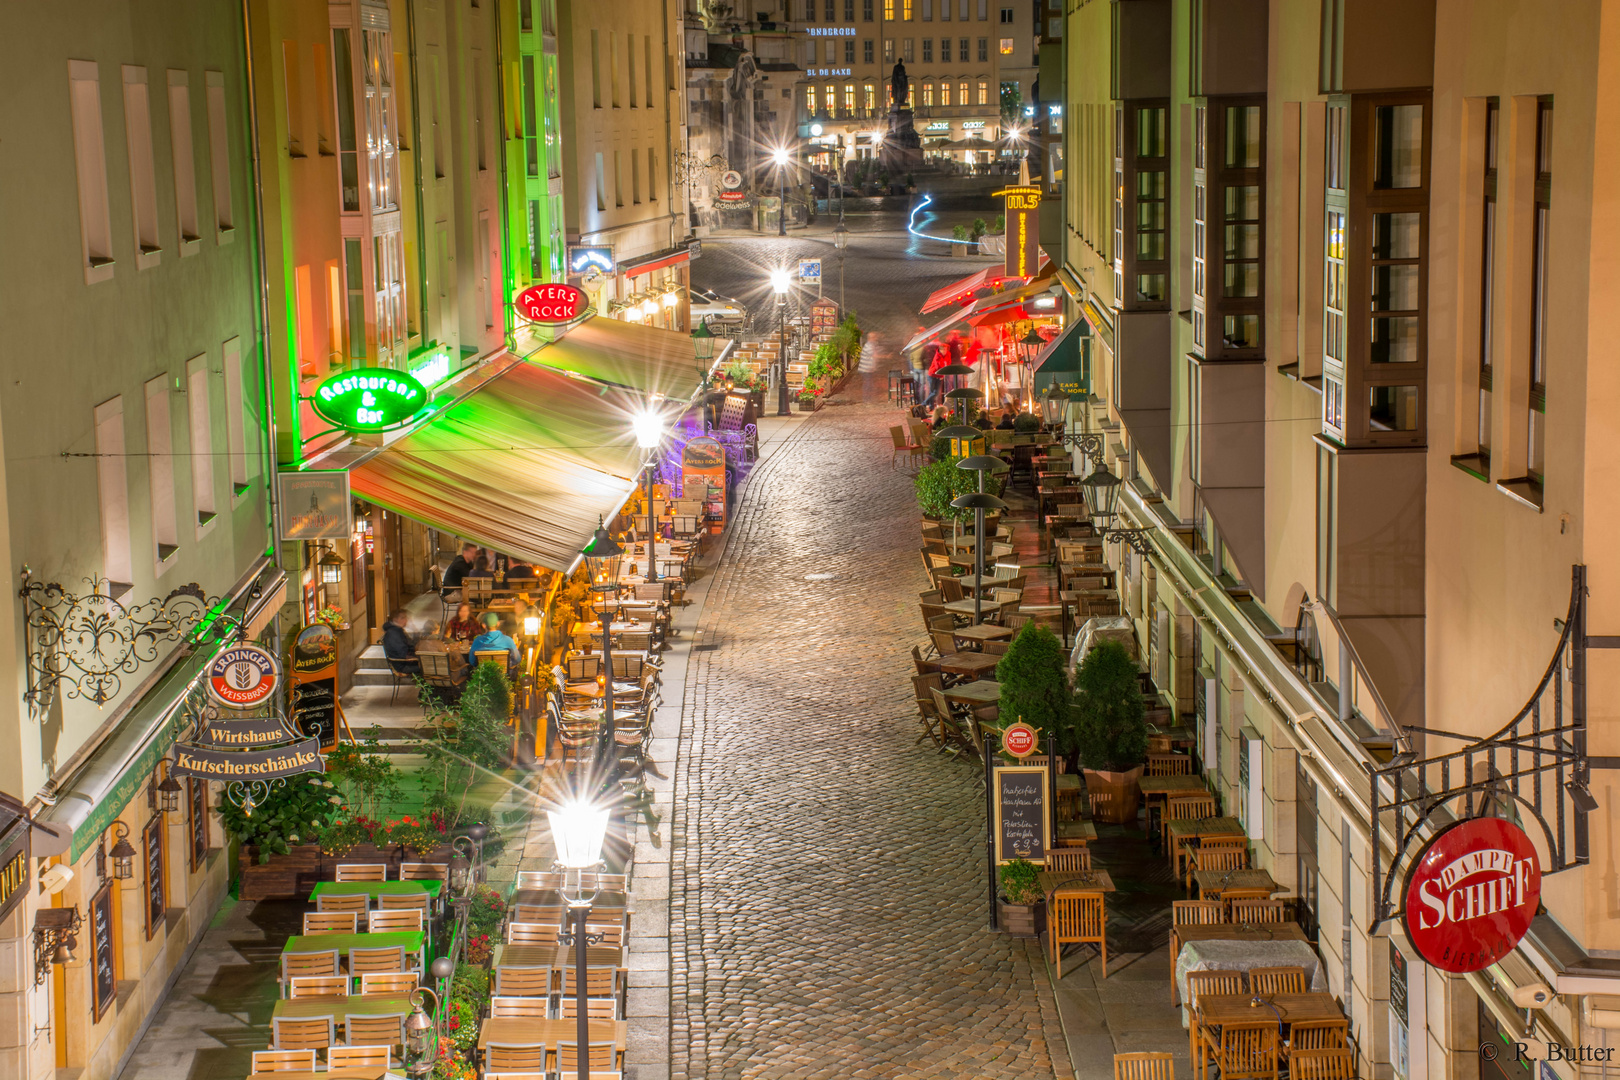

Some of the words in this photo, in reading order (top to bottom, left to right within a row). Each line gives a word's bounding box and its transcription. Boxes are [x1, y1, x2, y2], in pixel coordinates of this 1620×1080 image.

[831, 68, 851, 76] SAXE
[715, 201, 750, 210] edelweiss
[525, 288, 576, 305] AYERS
[531, 306, 573, 317] ROCK
[319, 376, 418, 401] Restaurant
[361, 391, 377, 407] &
[356, 407, 384, 424] Bar
[214, 650, 271, 674] ERDINGER
[219, 682, 269, 701] WEISSBRÄU
[210, 728, 283, 743] Wirtshaus
[1008, 736, 1032, 745] SCHIFF
[176, 751, 316, 775] Kutscherschänke
[0, 850, 27, 904] NKE
[1442, 852, 1513, 888] DAMPF
[1419, 857, 1534, 930] SCHIFF
[1443, 933, 1512, 967] BIERHAUS
